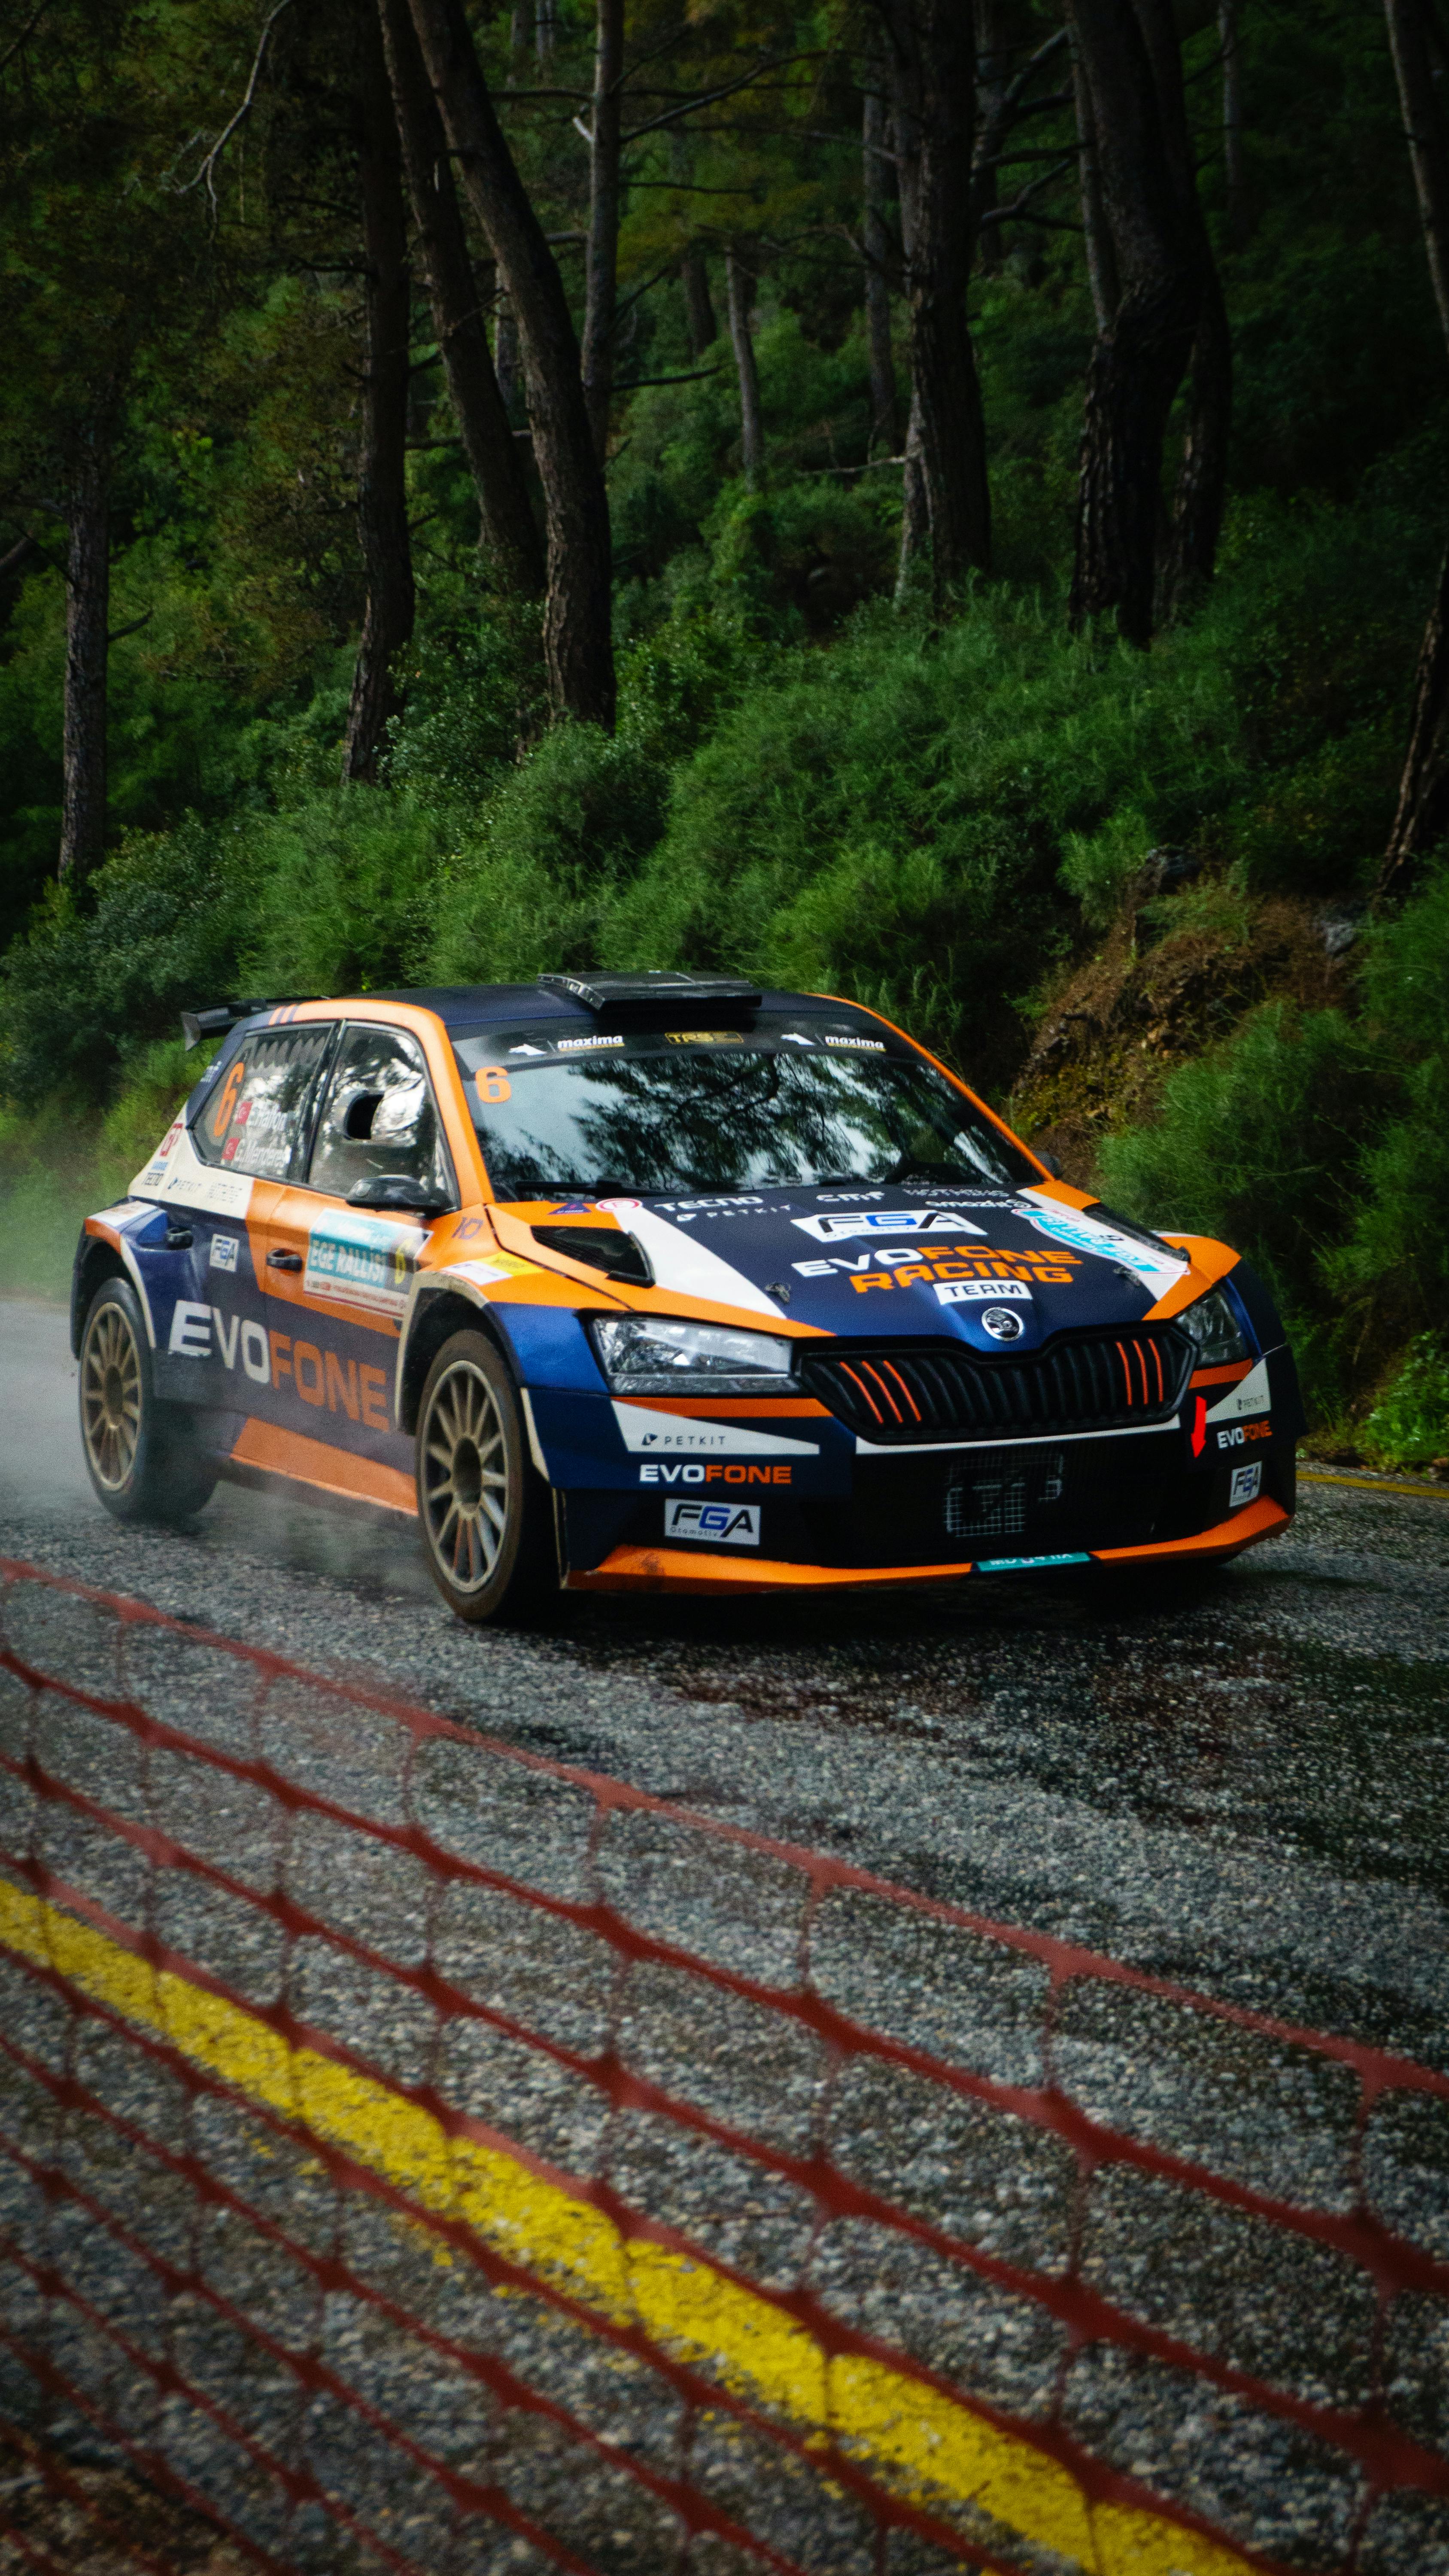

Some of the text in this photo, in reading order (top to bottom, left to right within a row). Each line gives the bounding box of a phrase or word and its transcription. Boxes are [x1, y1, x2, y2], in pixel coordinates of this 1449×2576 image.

[558, 1035, 623, 1048] maxima
[825, 1036, 884, 1048] maxima
[475, 1066, 511, 1103] 6
[213, 1062, 244, 1136] 6
[654, 1196, 763, 1211] TECNO
[706, 1204, 790, 1218] PETKIT
[817, 1212, 966, 1233] FGA
[212, 1238, 236, 1266] FGA
[308, 1240, 334, 1270] EGE
[791, 1245, 1083, 1277] EVOFONE
[849, 1262, 1074, 1294] RACING
[944, 1284, 1023, 1298] TEAM
[168, 1300, 389, 1432] EVOFONE
[665, 1436, 726, 1445] PETKIT
[1217, 1420, 1273, 1449] EVOFONE
[639, 1464, 792, 1484] EVOFONE
[672, 1504, 753, 1537] FGA
